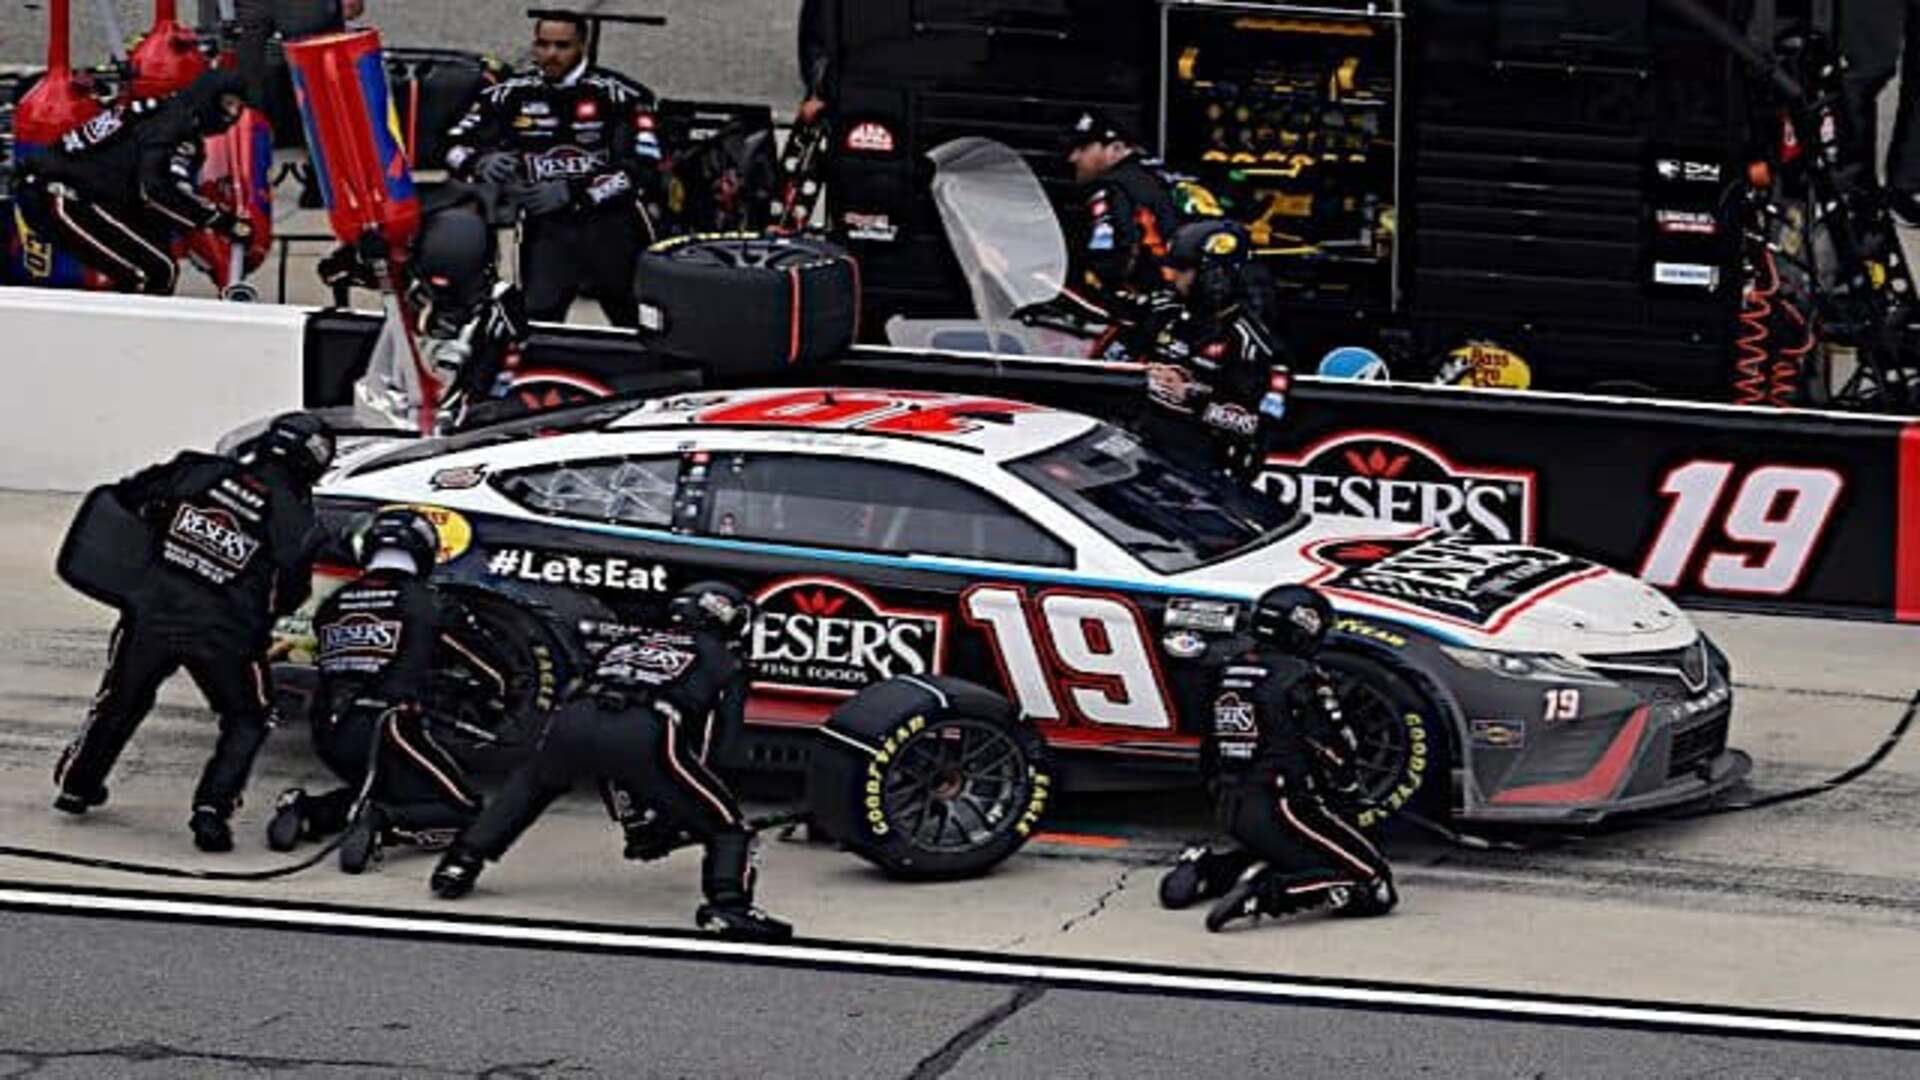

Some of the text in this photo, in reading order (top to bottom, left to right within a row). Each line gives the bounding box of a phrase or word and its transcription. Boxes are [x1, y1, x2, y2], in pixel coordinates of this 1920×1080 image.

[487, 549, 668, 592] #LetsEat
[1640, 461, 1844, 593] 19
[740, 604, 926, 680] ESER'S
[966, 586, 1172, 730] 19
[1543, 689, 1580, 721] 19
[866, 714, 926, 836] GOODYEAR
